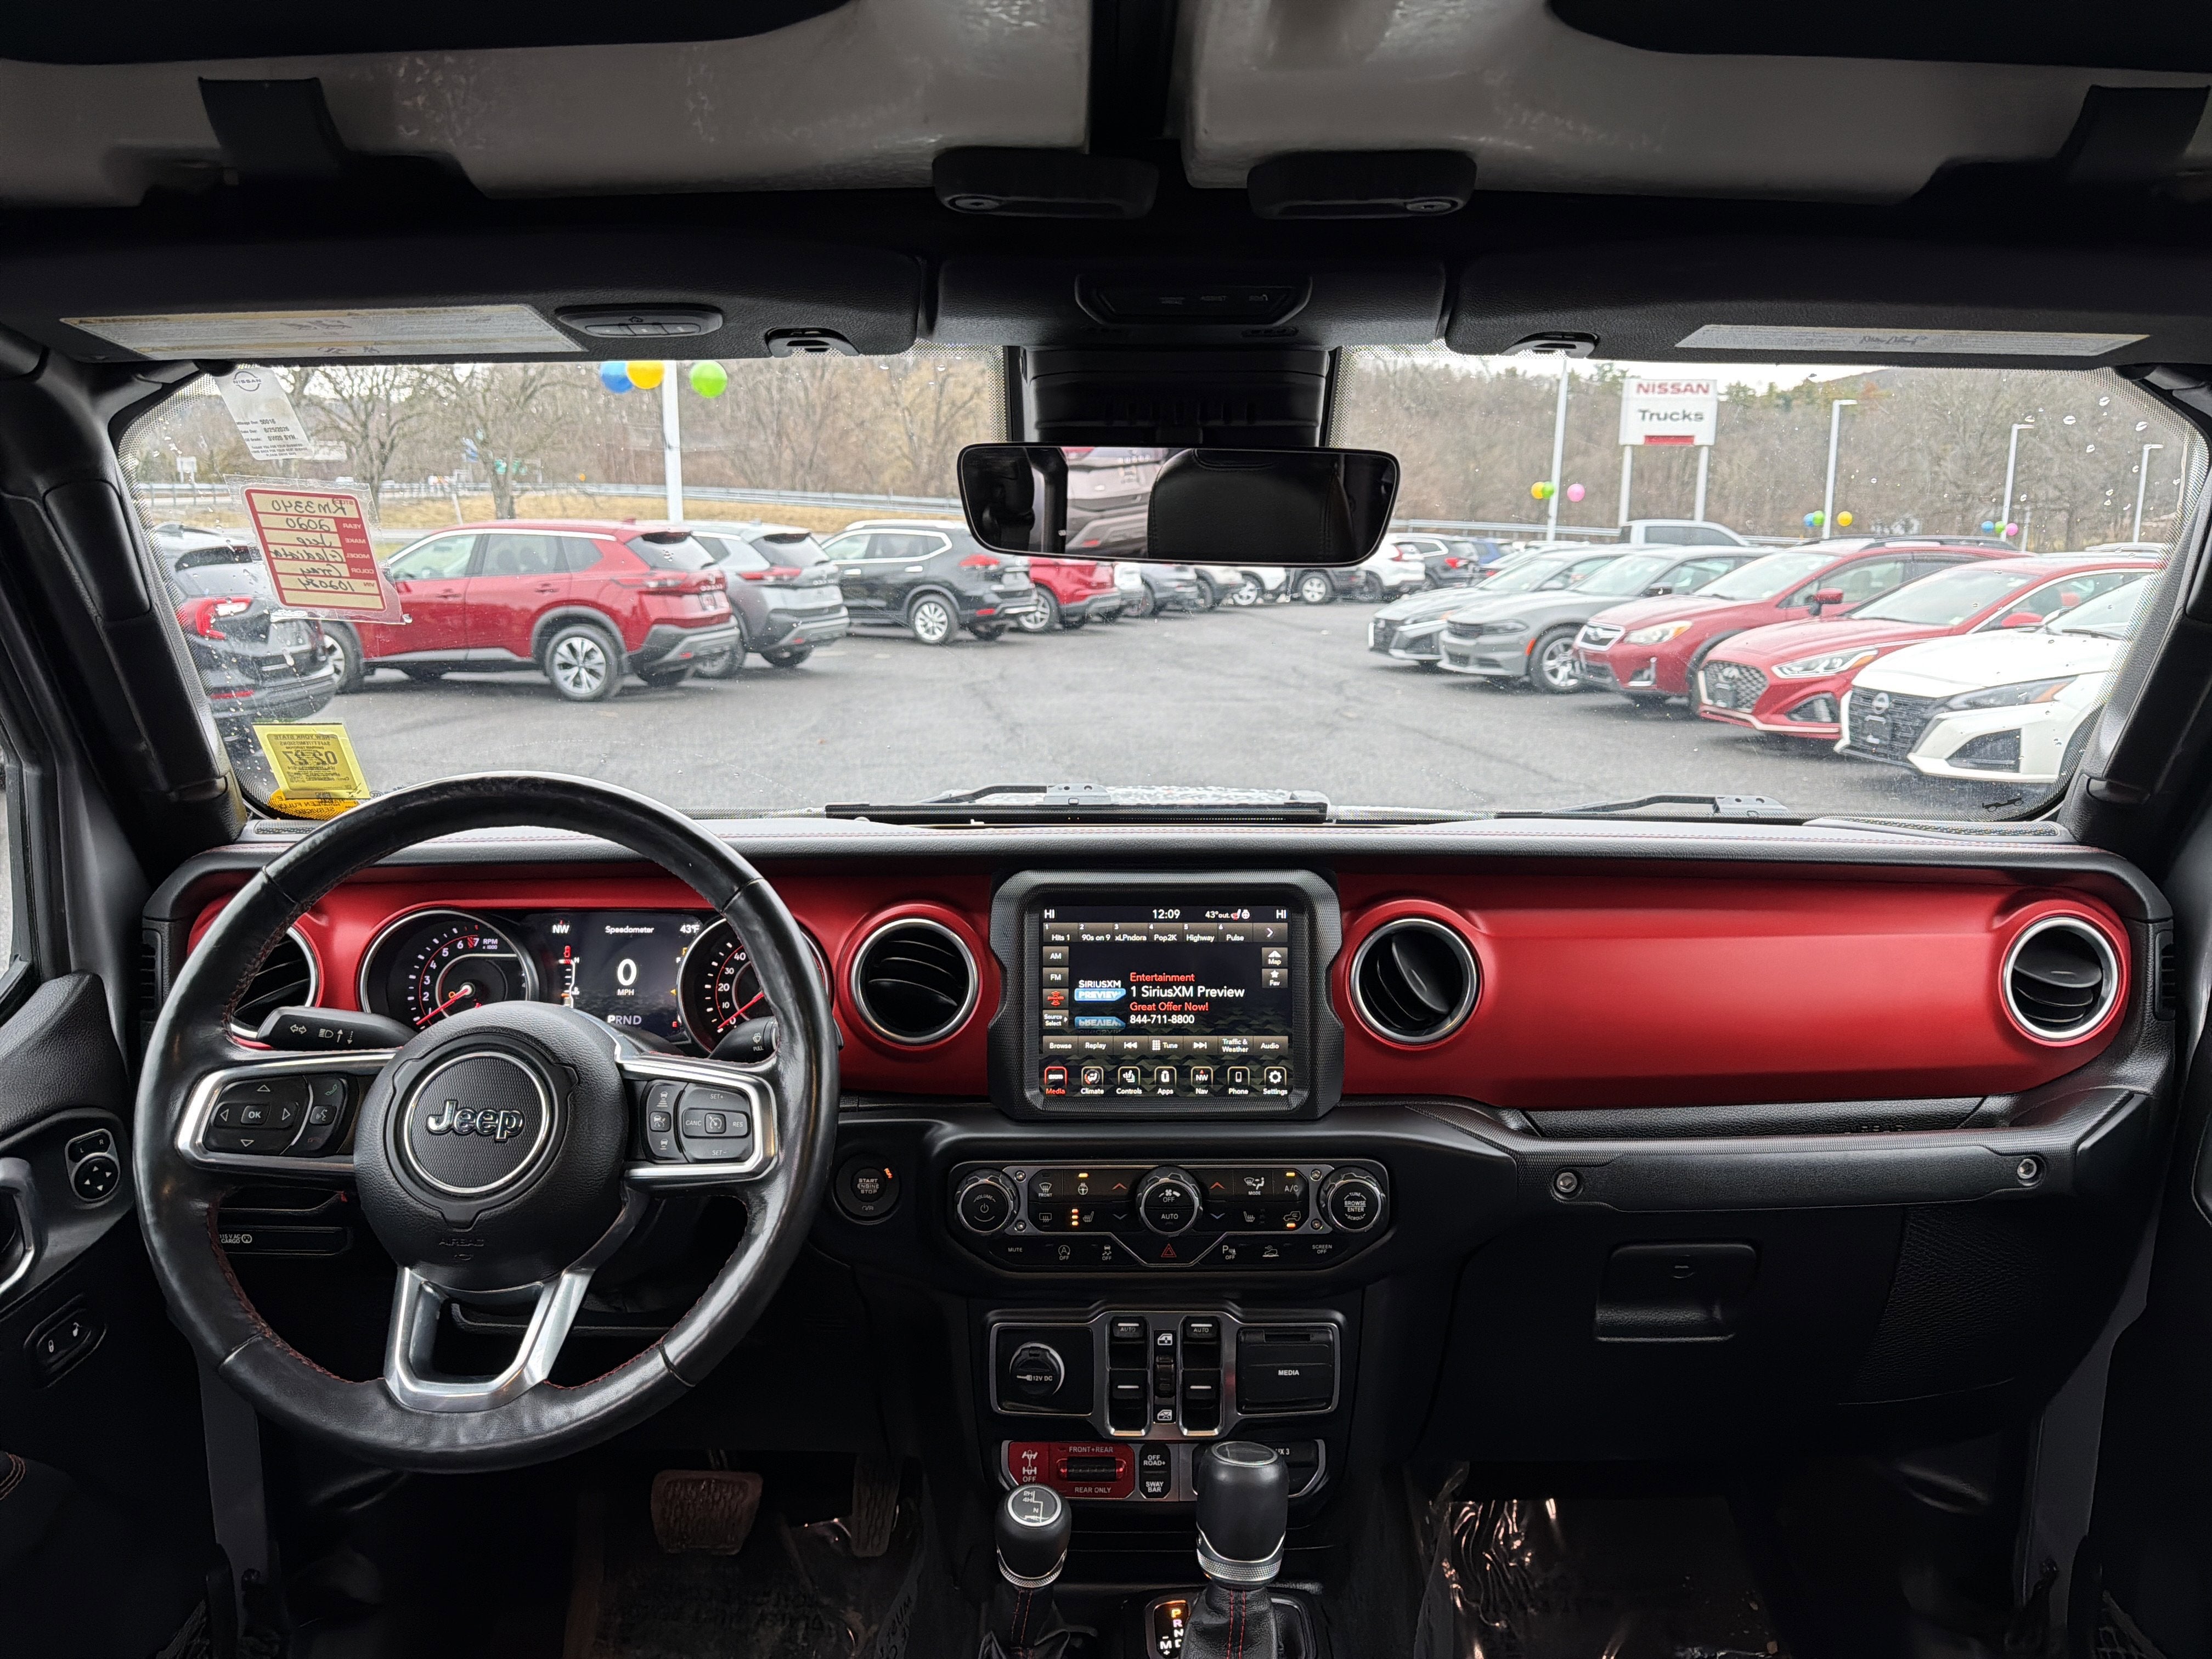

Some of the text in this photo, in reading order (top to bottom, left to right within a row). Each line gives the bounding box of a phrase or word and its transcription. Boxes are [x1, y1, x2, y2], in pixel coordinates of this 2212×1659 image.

[1637, 382, 1710, 394] NISSAN
[1638, 409, 1705, 421] Trucks
[1044, 909, 1056, 919] HI
[1153, 909, 1180, 919] 12:09
[1276, 909, 1286, 919] HI
[605, 926, 654, 934] Speedometer
[473, 938, 479, 946] 7
[1186, 934, 1215, 943] Highway
[457, 940, 464, 949] 6
[442, 947, 449, 957] 5
[734, 952, 746, 961] 40
[430, 960, 437, 969] 4
[617, 958, 637, 986] 0
[1130, 972, 1195, 981] Entertainment
[424, 976, 430, 985] 3
[718, 983, 730, 991] 20
[1131, 986, 1245, 997] 1 SiriusXM Preview
[422, 992, 429, 1001] 2
[1130, 1002, 1209, 1011] Great Offer Now!
[1130, 1014, 1195, 1024] 844-711-8800
[248, 1110, 261, 1119] OK
[426, 1101, 526, 1143] Jeep
[1171, 1609, 1181, 1618] P
[1173, 1620, 1183, 1628] R
[1174, 1628, 1184, 1638] N
[1160, 1640, 1172, 1650] M
